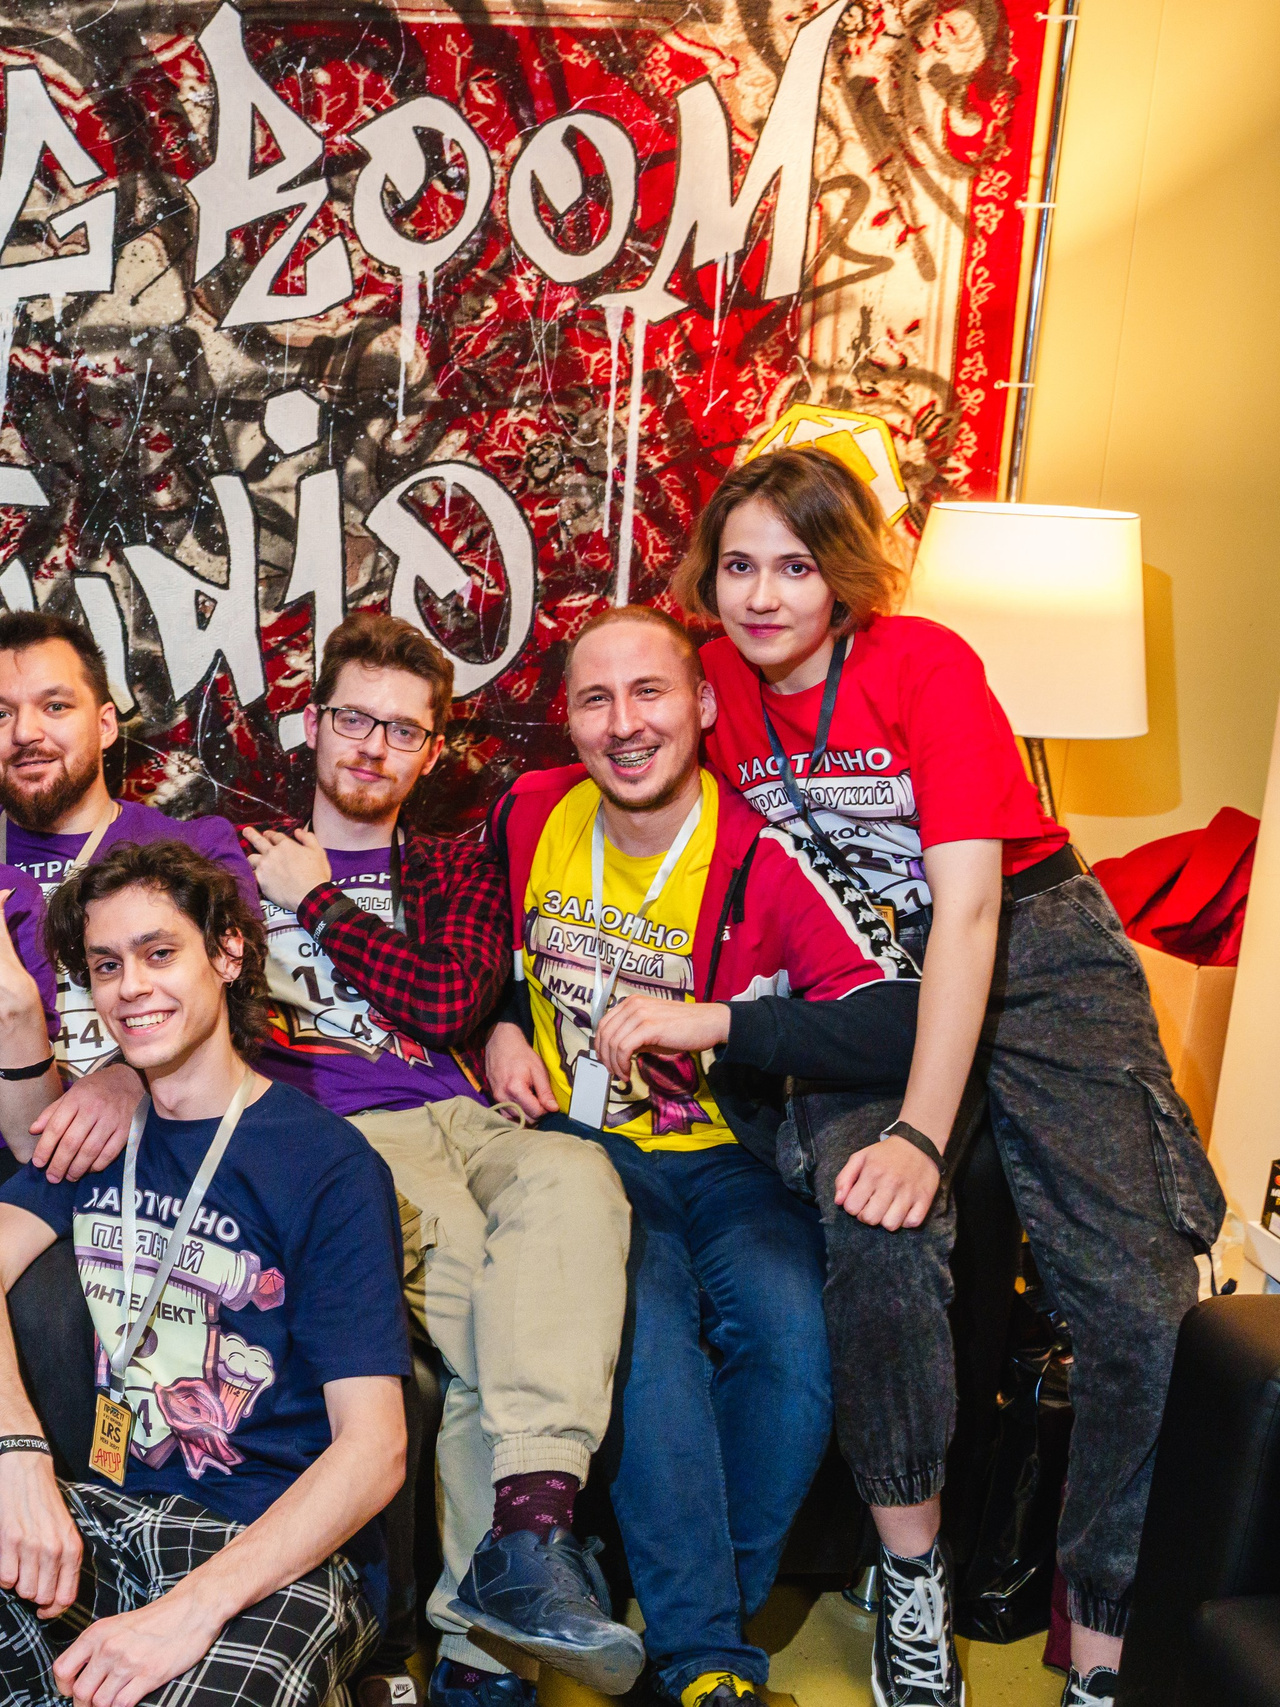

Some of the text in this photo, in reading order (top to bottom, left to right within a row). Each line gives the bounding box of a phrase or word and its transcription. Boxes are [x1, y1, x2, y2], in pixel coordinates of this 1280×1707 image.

[547, 925, 664, 979] ДУШНЫЙ
[91, 1222, 205, 1274] ПЬЯНЙ
[84, 1280, 196, 1325] ИНТЕЛЕКТ
[101, 1419, 122, 1444] LRS
[94, 1448, 122, 1473] АРТУР
